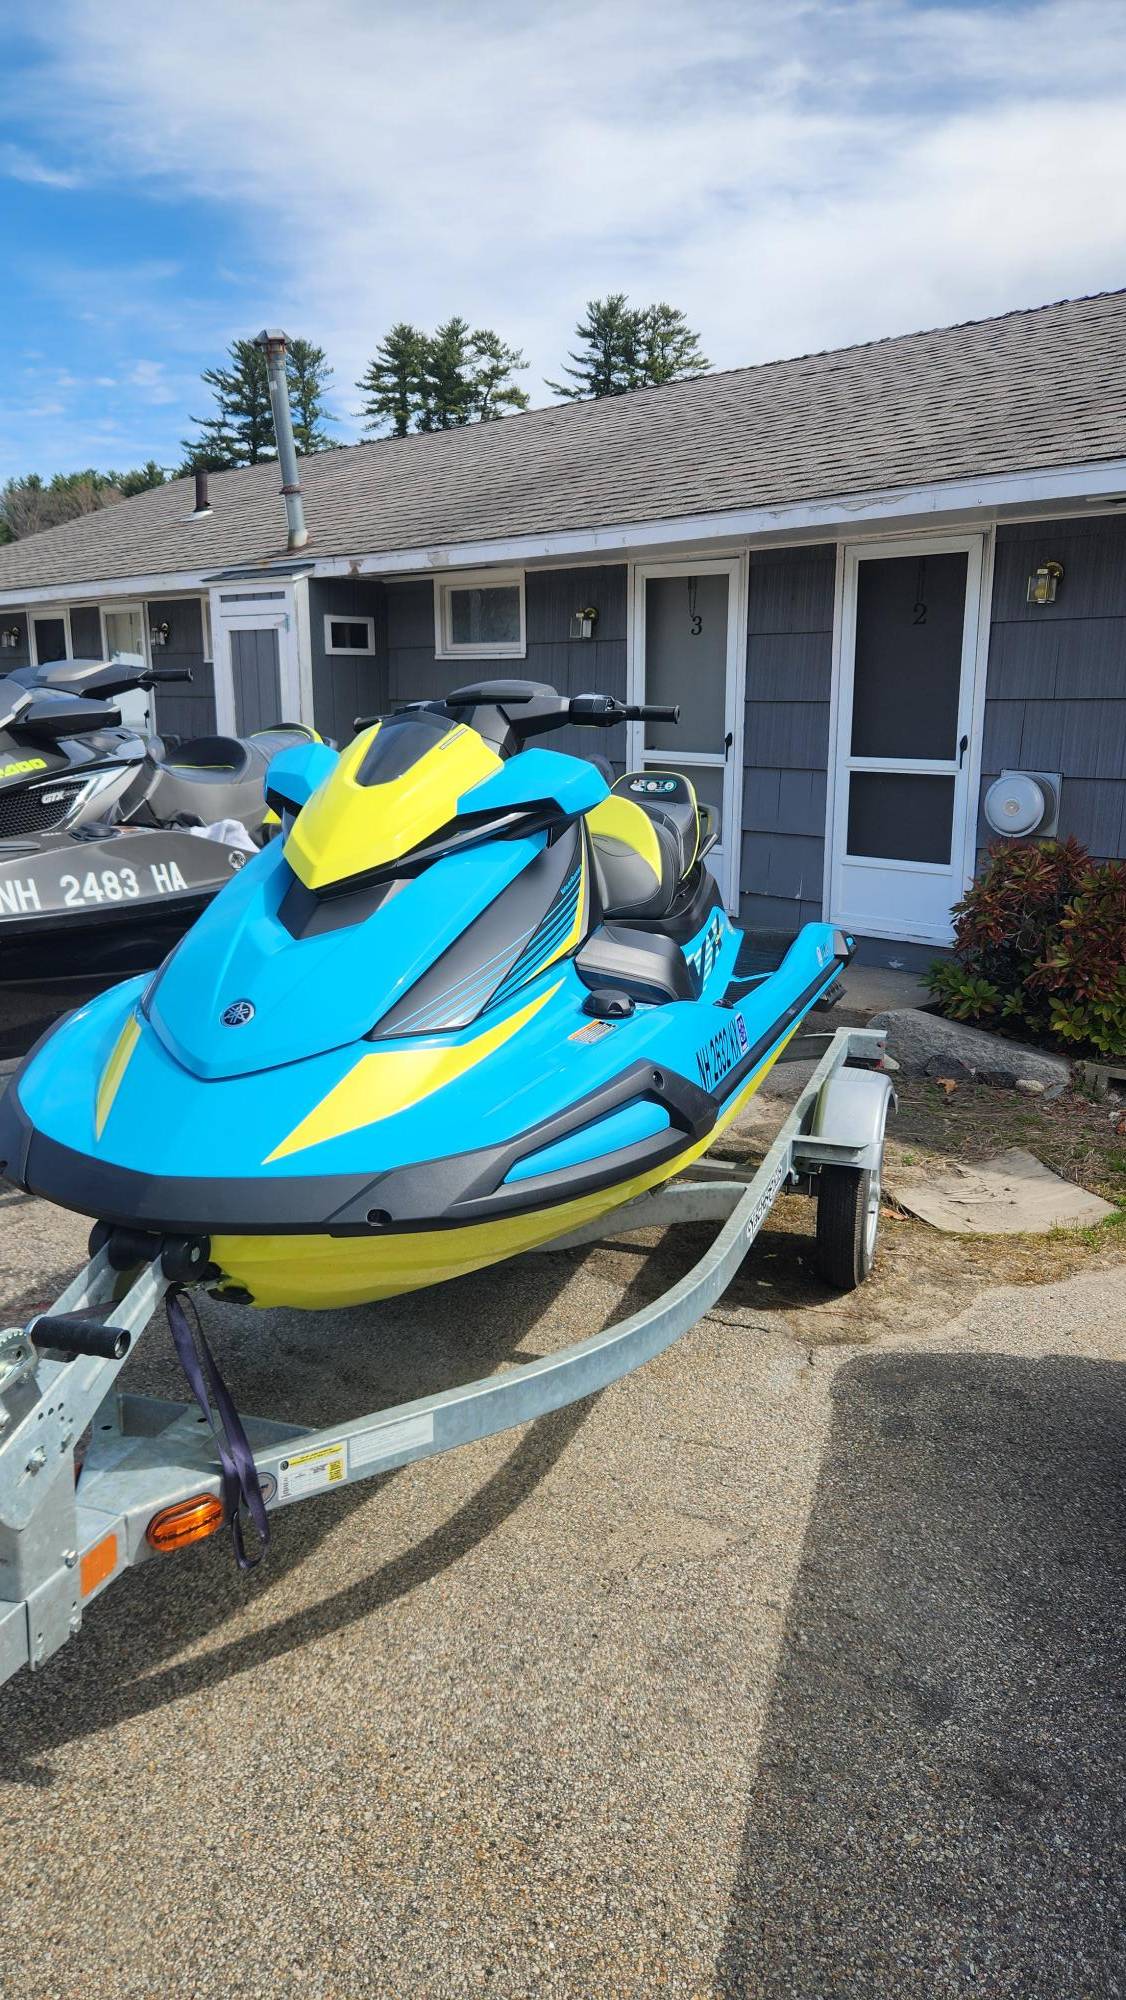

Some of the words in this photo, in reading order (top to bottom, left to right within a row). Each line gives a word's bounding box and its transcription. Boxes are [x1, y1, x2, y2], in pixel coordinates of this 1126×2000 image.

[913, 602, 927, 625] 2
[691, 615, 702, 635] 3
[41, 790, 65, 804] GTX
[0, 878, 42, 913] NH
[60, 868, 139, 907] 2483
[150, 861, 188, 894] HA
